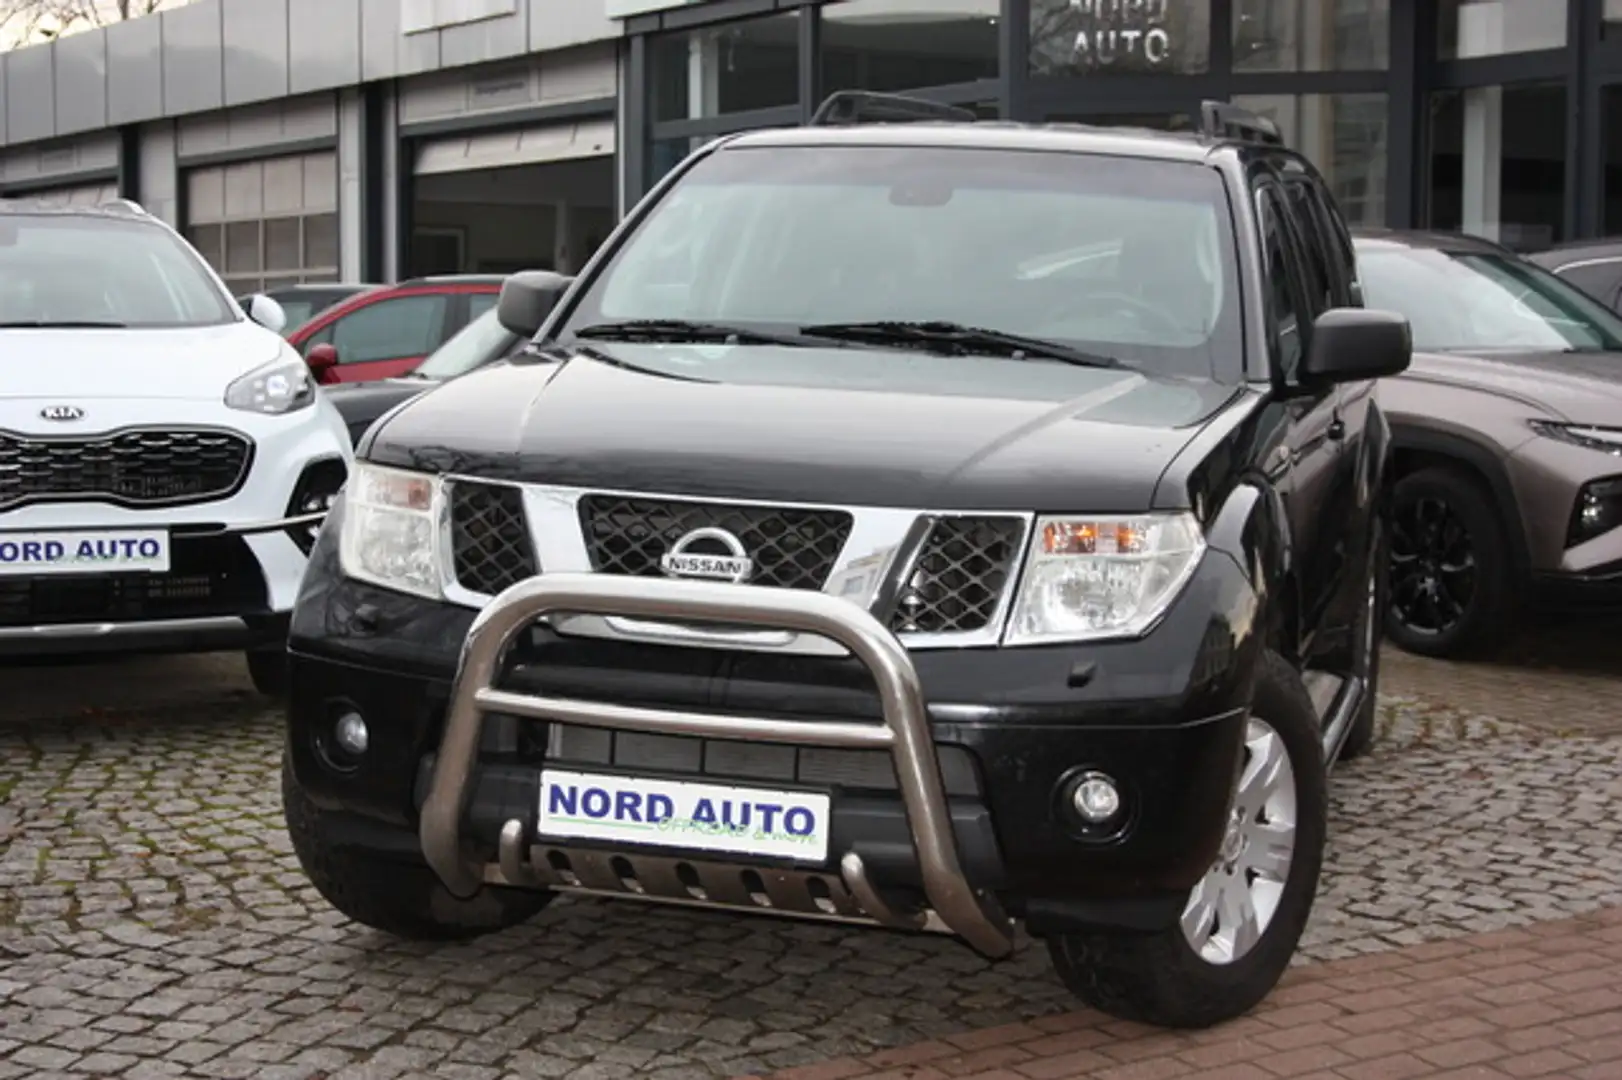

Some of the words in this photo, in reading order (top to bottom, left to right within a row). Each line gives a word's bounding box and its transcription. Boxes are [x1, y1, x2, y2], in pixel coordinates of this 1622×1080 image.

[1072, 28, 1169, 63] AUTO
[44, 406, 81, 419] KIA
[76, 538, 160, 559] AUTO
[669, 557, 741, 574] NISSAN
[549, 784, 674, 823] NORD
[690, 797, 816, 836] AUTO
